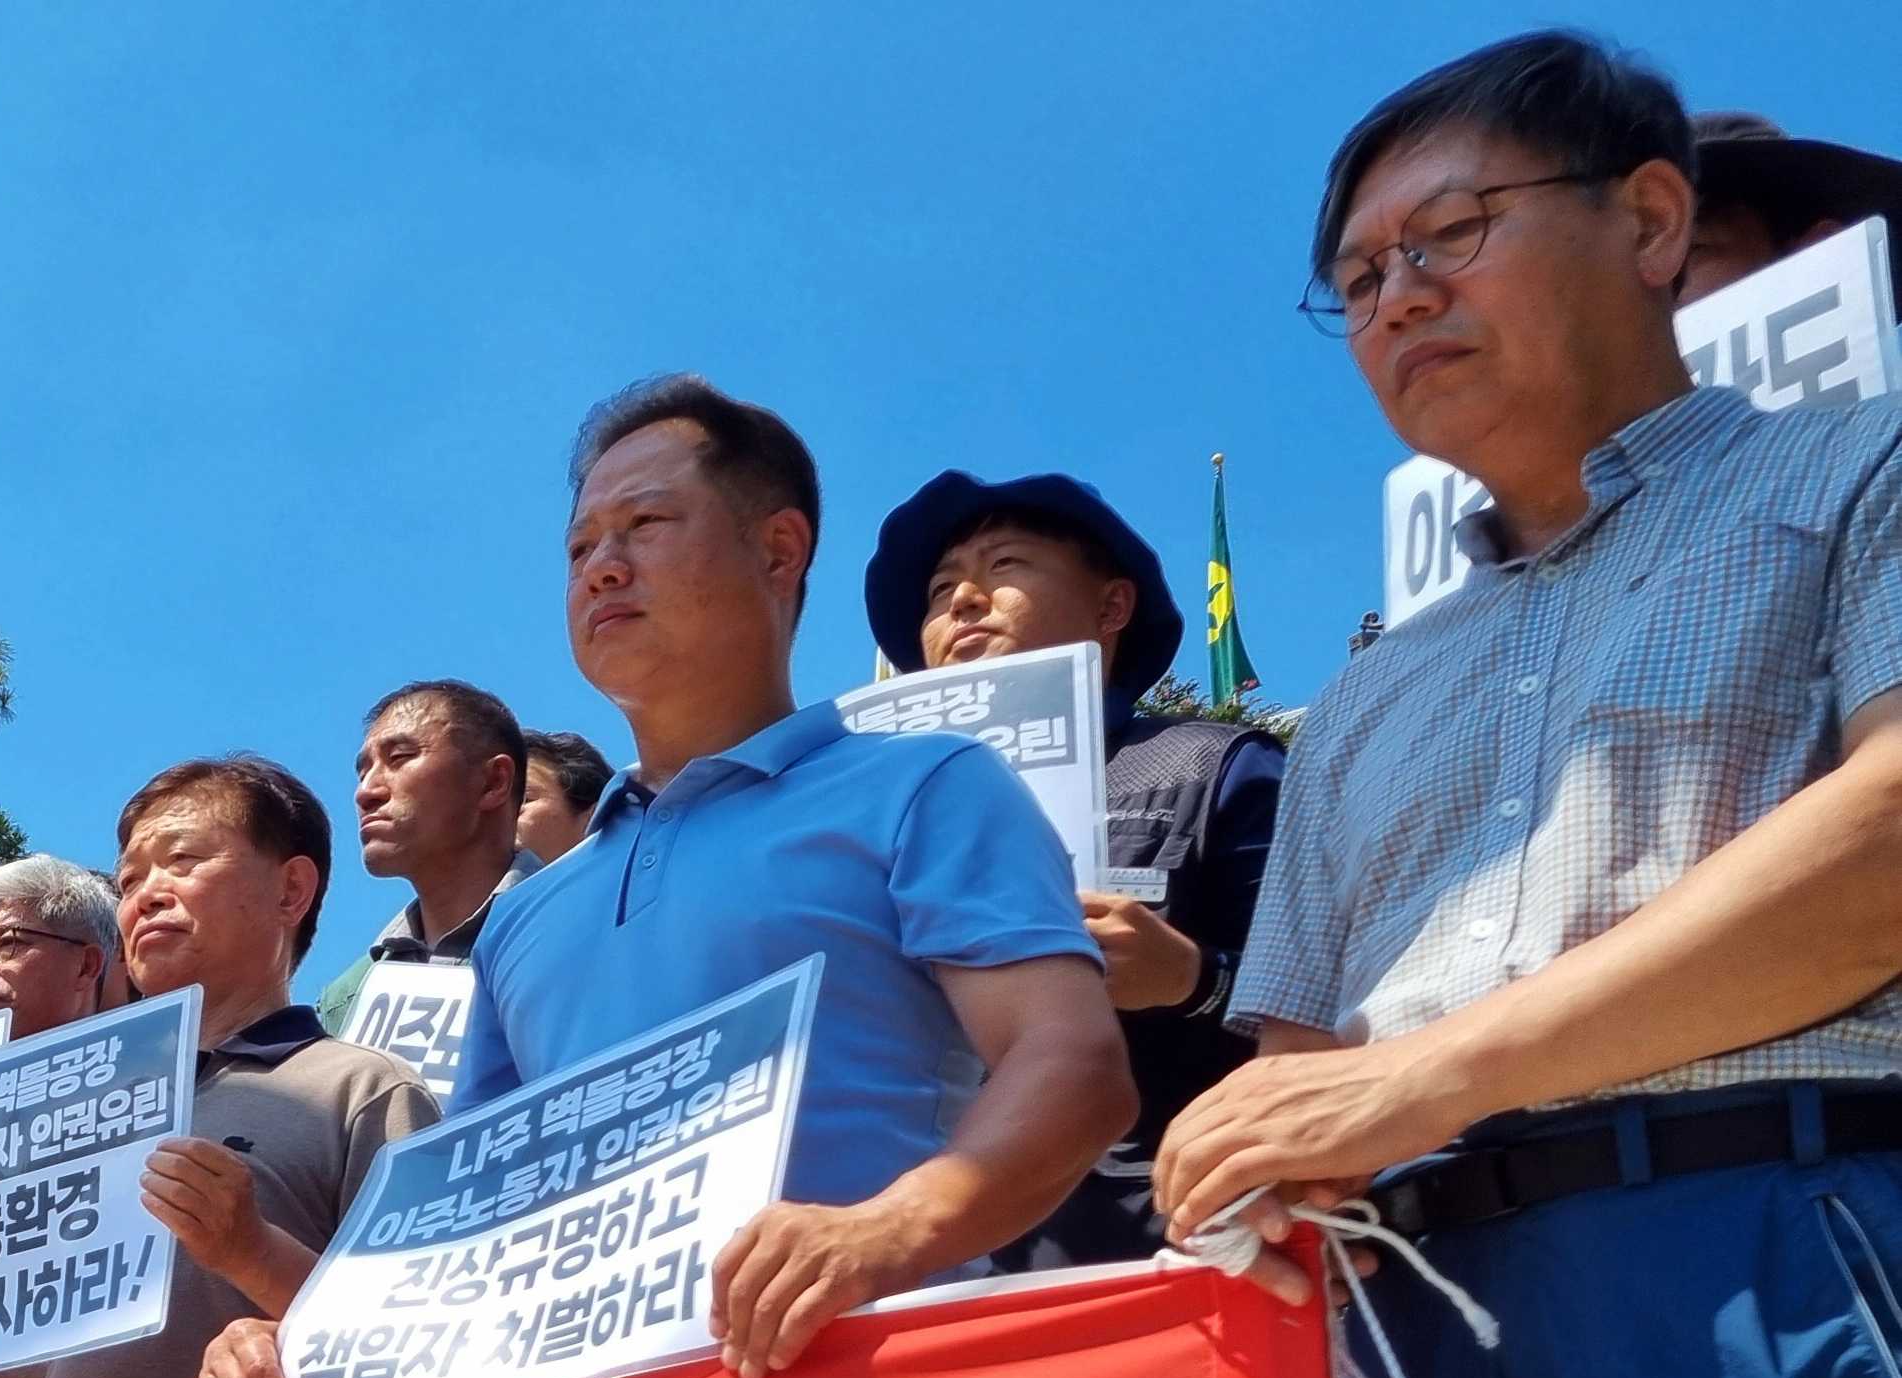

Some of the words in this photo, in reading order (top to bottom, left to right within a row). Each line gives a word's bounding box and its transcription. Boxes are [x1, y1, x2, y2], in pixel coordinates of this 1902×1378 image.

[29, 1077, 168, 1161] 인권유린
[368, 1145, 584, 1246] 이주노동자
[592, 1055, 775, 1181] 인권유린
[446, 1114, 531, 1182] 나주
[539, 1029, 722, 1138] 벽돌공장
[381, 1152, 709, 1309] 진상규명하고
